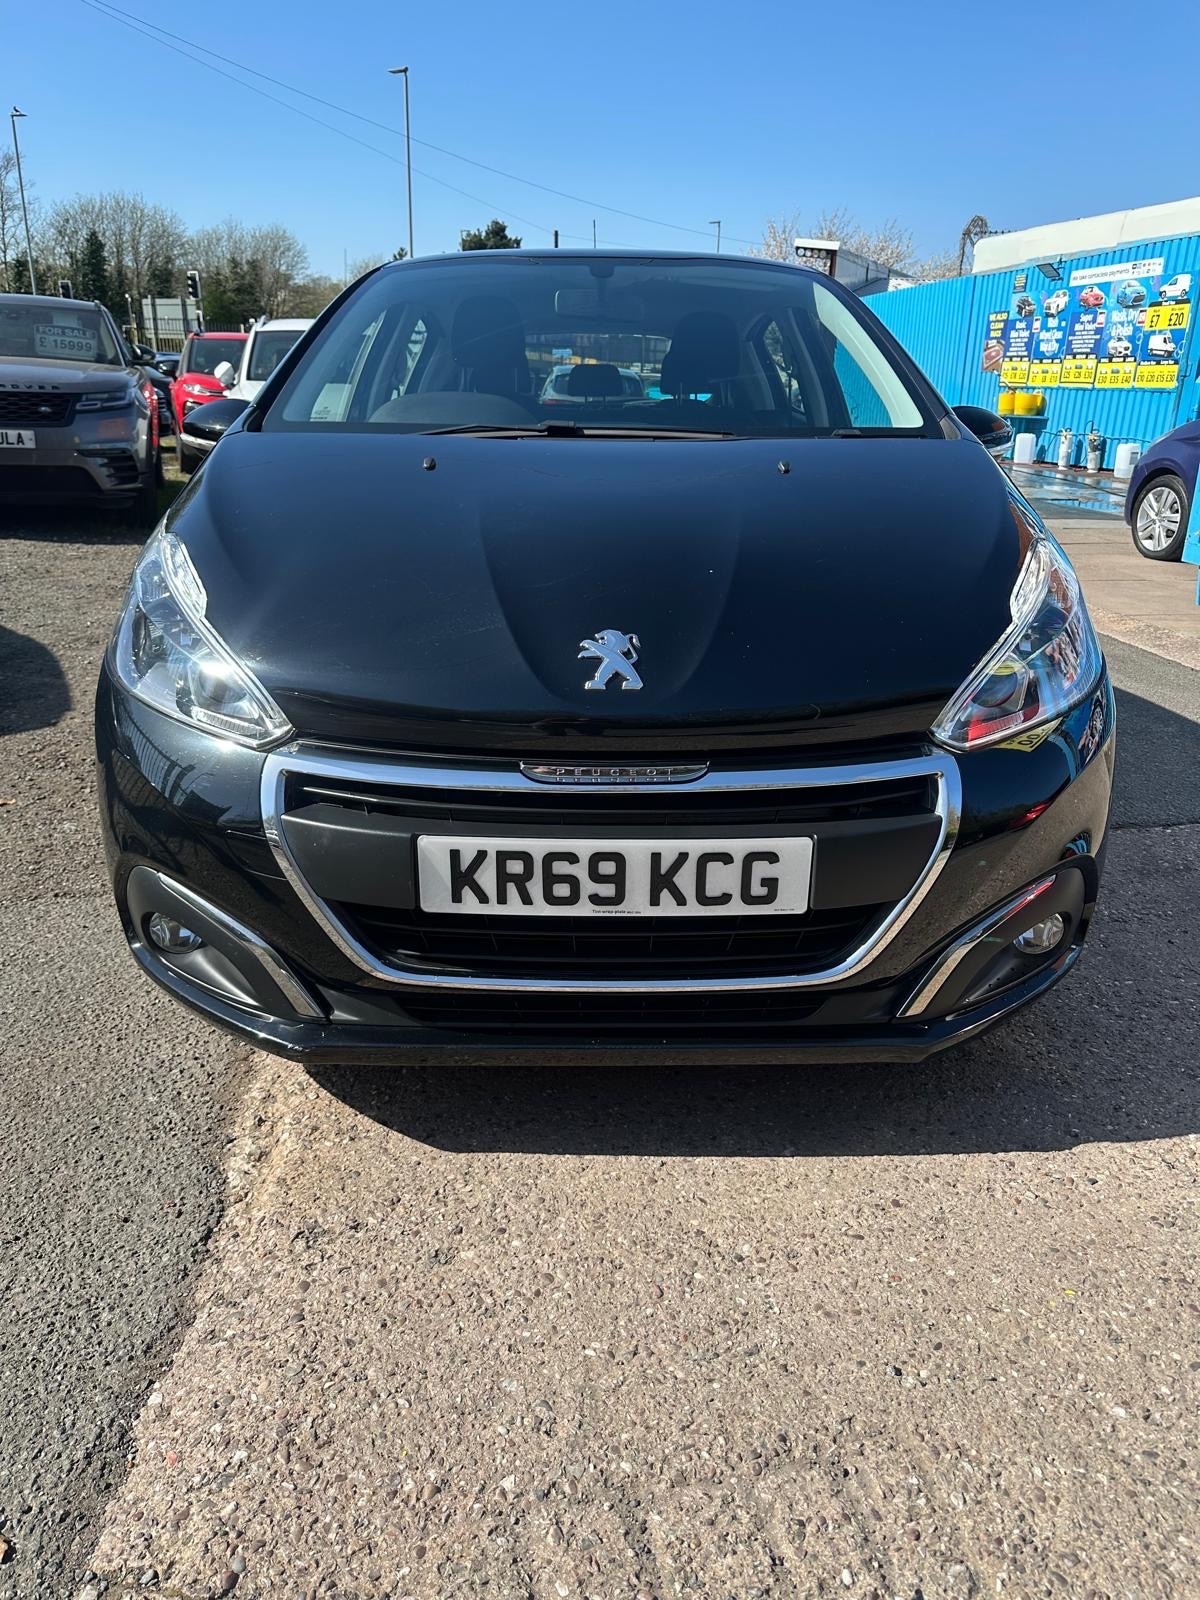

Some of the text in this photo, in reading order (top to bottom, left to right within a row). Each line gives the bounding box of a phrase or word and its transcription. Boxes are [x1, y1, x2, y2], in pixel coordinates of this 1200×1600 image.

[1108, 268, 1130, 277] payments
[996, 312, 1008, 321] ALSO
[1080, 313, 1094, 323] Super
[1150, 314, 1160, 328] £7
[1168, 312, 1184, 326] £20
[39, 326, 91, 338] FOR SALE
[40, 336, 92, 352] £ 15999
[1097, 375, 1131, 384] £30 £35 £40
[556, 767, 674, 777] PEUGEOT
[449, 848, 780, 906] KR69 KCG
